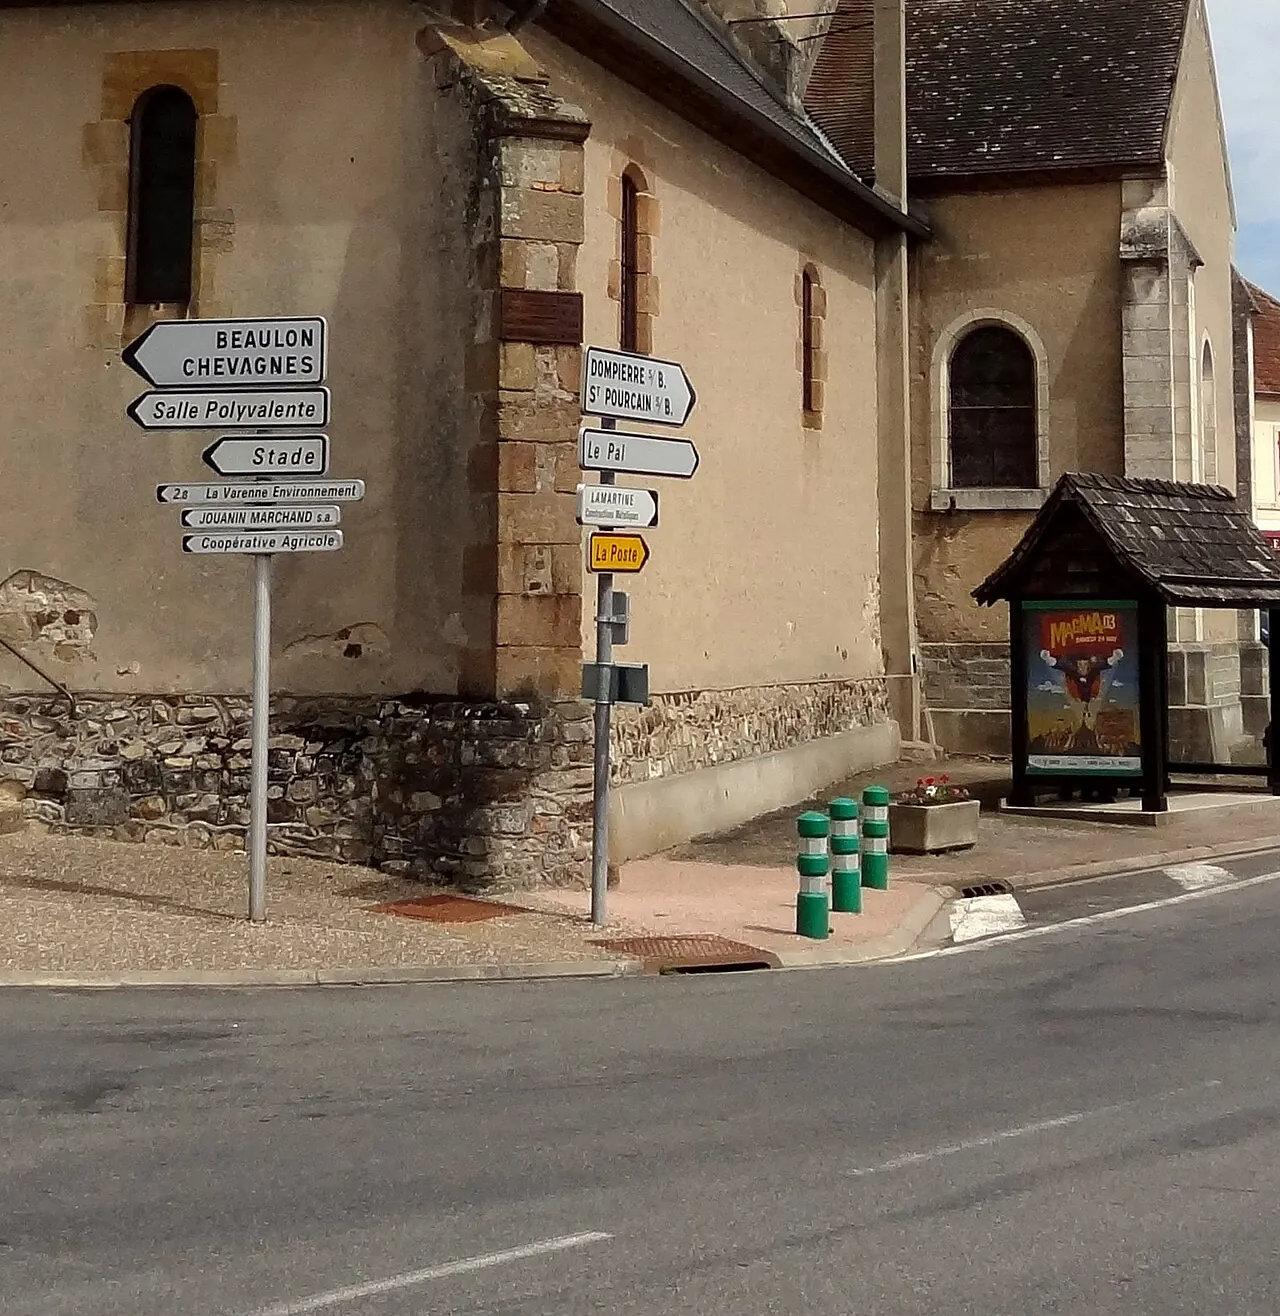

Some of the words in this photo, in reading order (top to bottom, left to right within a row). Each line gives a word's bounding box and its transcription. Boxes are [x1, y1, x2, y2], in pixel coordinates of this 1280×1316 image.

[216, 328, 314, 350] BEAULON
[183, 355, 313, 377] CHEVAGNES
[591, 358, 645, 385] DOMPIERRE
[605, 387, 652, 411] POURCAIN
[153, 401, 198, 420] Salle
[205, 400, 316, 422] Polyvalente
[252, 447, 315, 466] Stade
[588, 440, 601, 460] Le
[607, 441, 625, 462] Pal
[206, 487, 218, 499] La
[223, 486, 268, 499] Varenne
[272, 484, 357, 498] Environnement
[591, 491, 634, 506] LAMARTINE
[199, 512, 246, 524] JOUANIN
[250, 511, 312, 524] MARCHAND
[201, 536, 276, 551] Coopérative
[281, 534, 334, 551] Agricole
[596, 544, 606, 561] La
[610, 544, 638, 562] Poste
